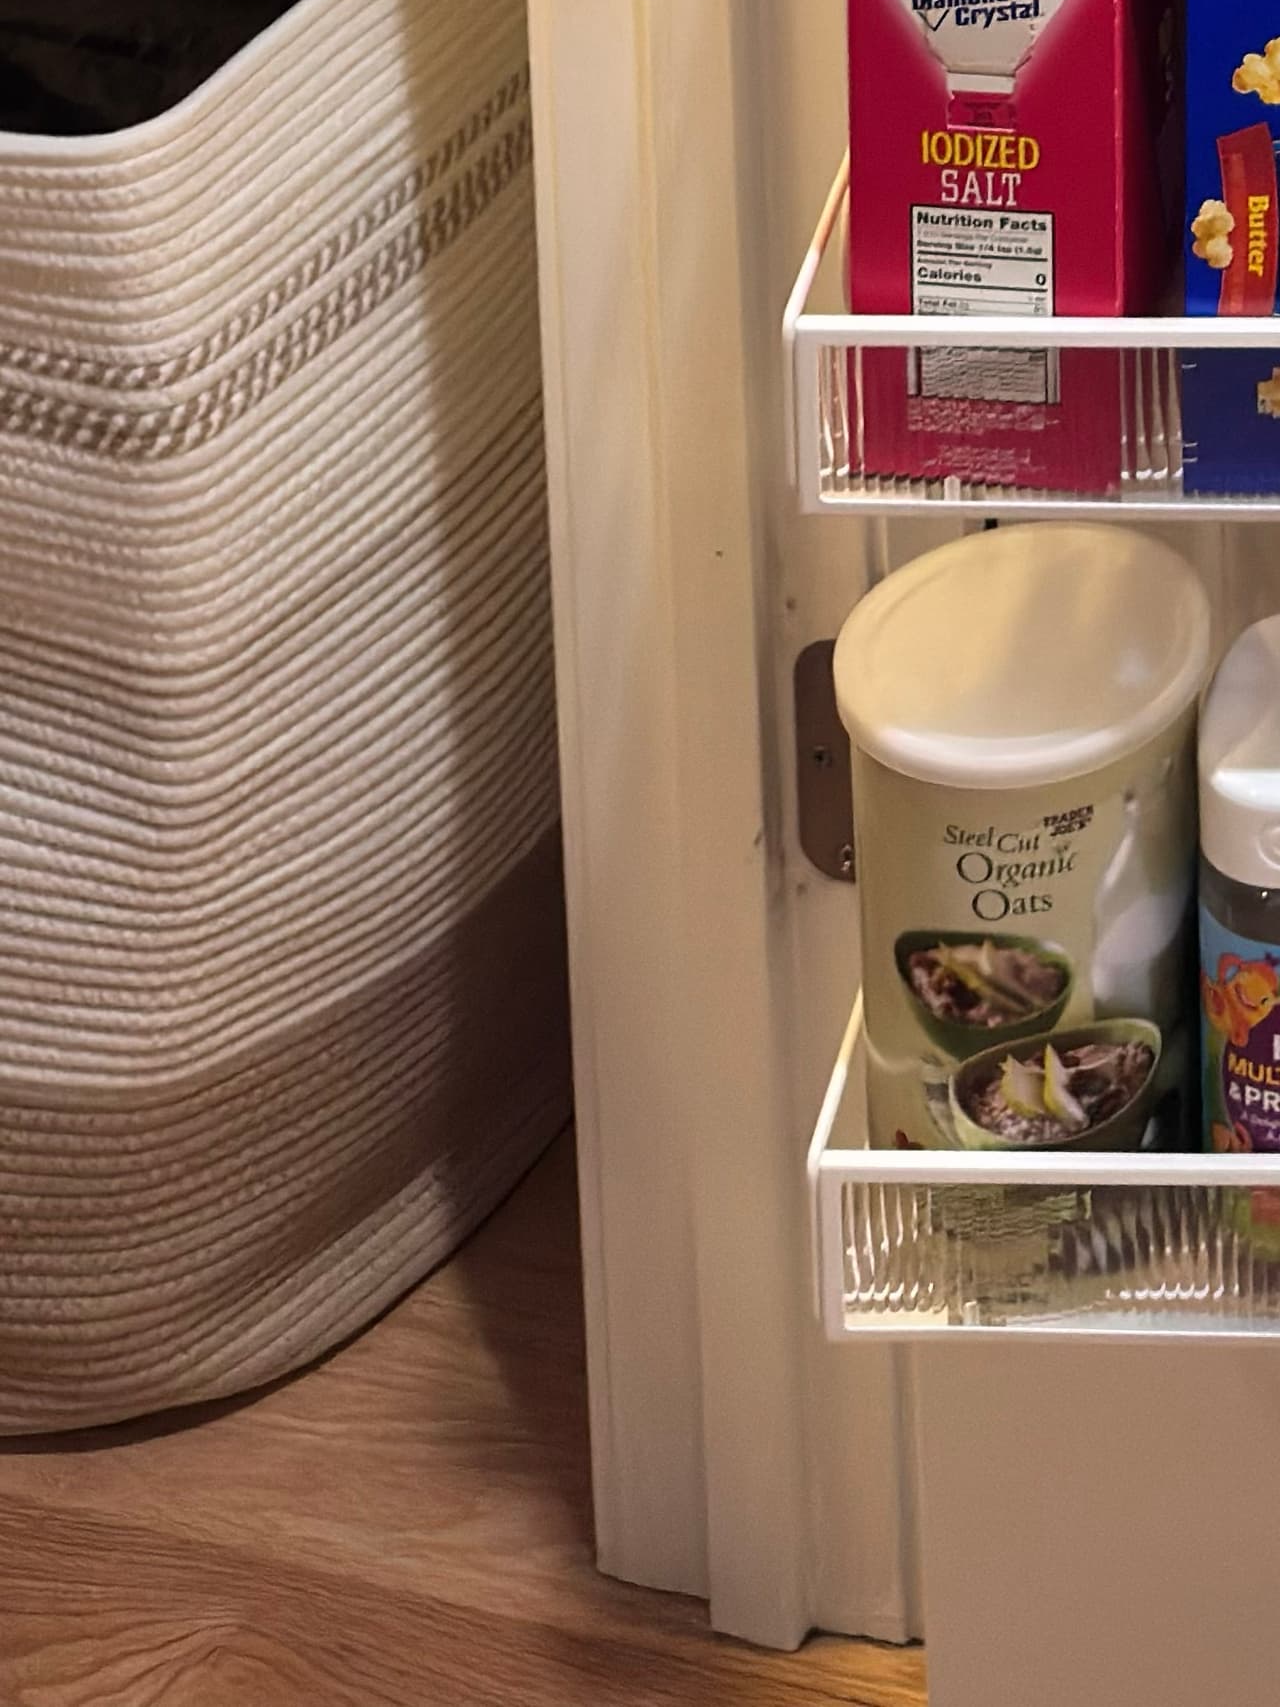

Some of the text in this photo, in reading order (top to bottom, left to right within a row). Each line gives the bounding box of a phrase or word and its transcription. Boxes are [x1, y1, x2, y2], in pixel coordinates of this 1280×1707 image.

[922, 130, 1040, 169] IODIZED
[941, 169, 1021, 206] SALT
[917, 211, 1047, 231] Nutrition Facts
[1248, 194, 1270, 277] Butter
[917, 267, 1046, 285] Calories 0
[1043, 804, 1094, 828] TRADER
[944, 825, 1040, 853] Steel Cut
[956, 852, 1077, 888] Organic
[972, 889, 1053, 921] Oats
[1228, 1082, 1242, 1101] &
